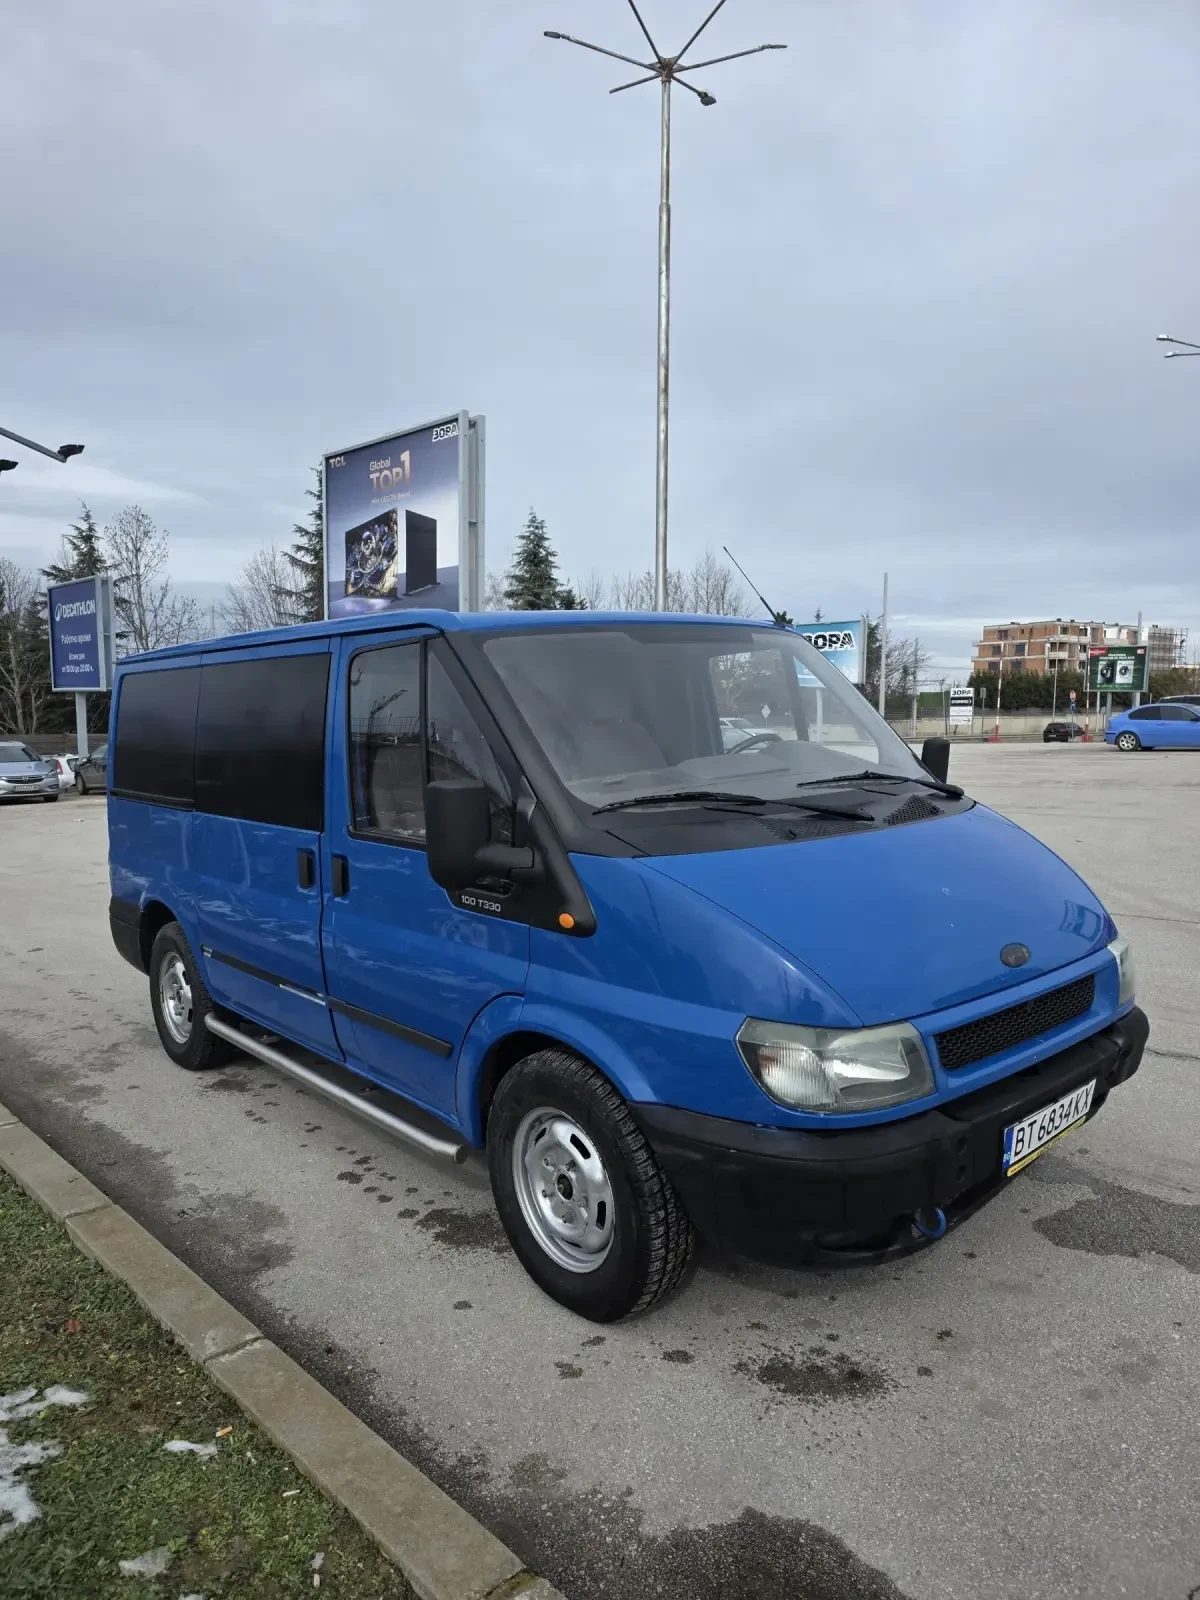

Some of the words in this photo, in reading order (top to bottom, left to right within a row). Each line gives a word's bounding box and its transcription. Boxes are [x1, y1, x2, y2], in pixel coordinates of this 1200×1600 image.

[432, 422, 458, 441] ЗОРА
[329, 456, 346, 469] TCL
[369, 456, 391, 471] Global
[62, 599, 96, 619] DECATHLON
[461, 895, 476, 906] 100
[478, 899, 502, 912] T330
